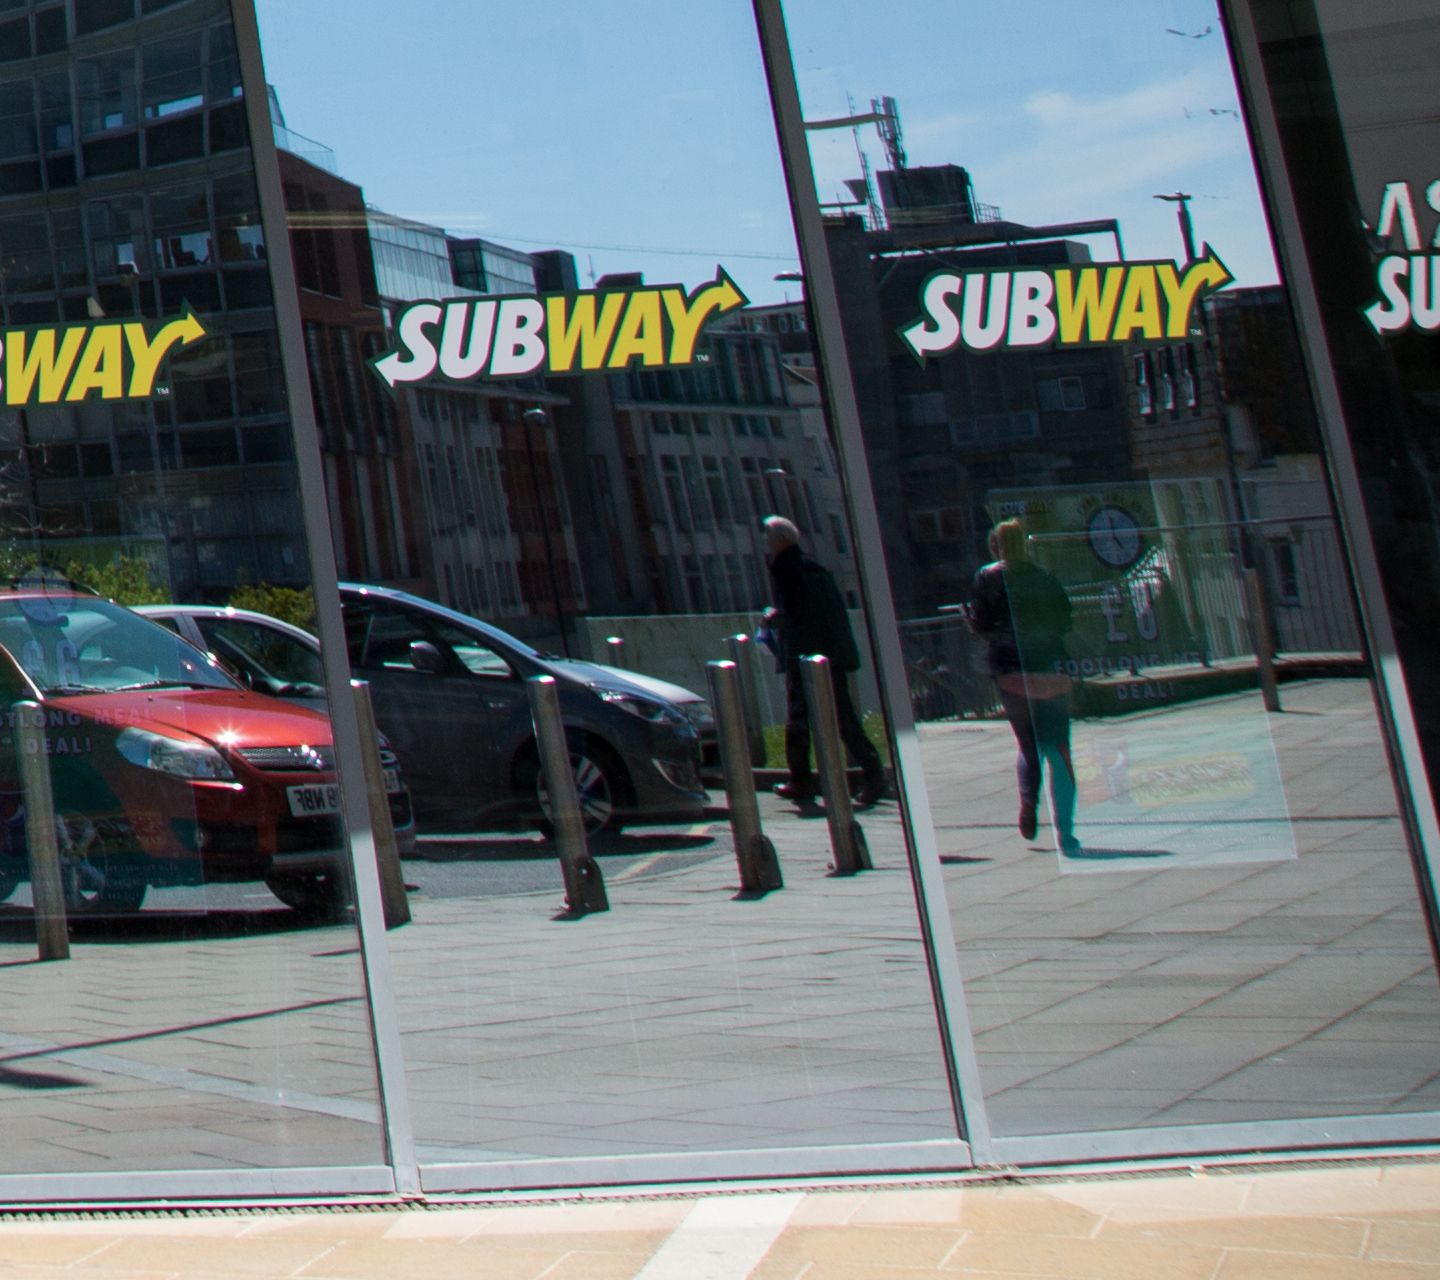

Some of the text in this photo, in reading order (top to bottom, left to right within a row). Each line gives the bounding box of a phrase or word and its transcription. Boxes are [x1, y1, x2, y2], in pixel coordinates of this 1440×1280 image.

[375, 278, 746, 387] SUBWAY
[902, 251, 1232, 360] SUBWAY
[24, 735, 93, 755] DEAL!
